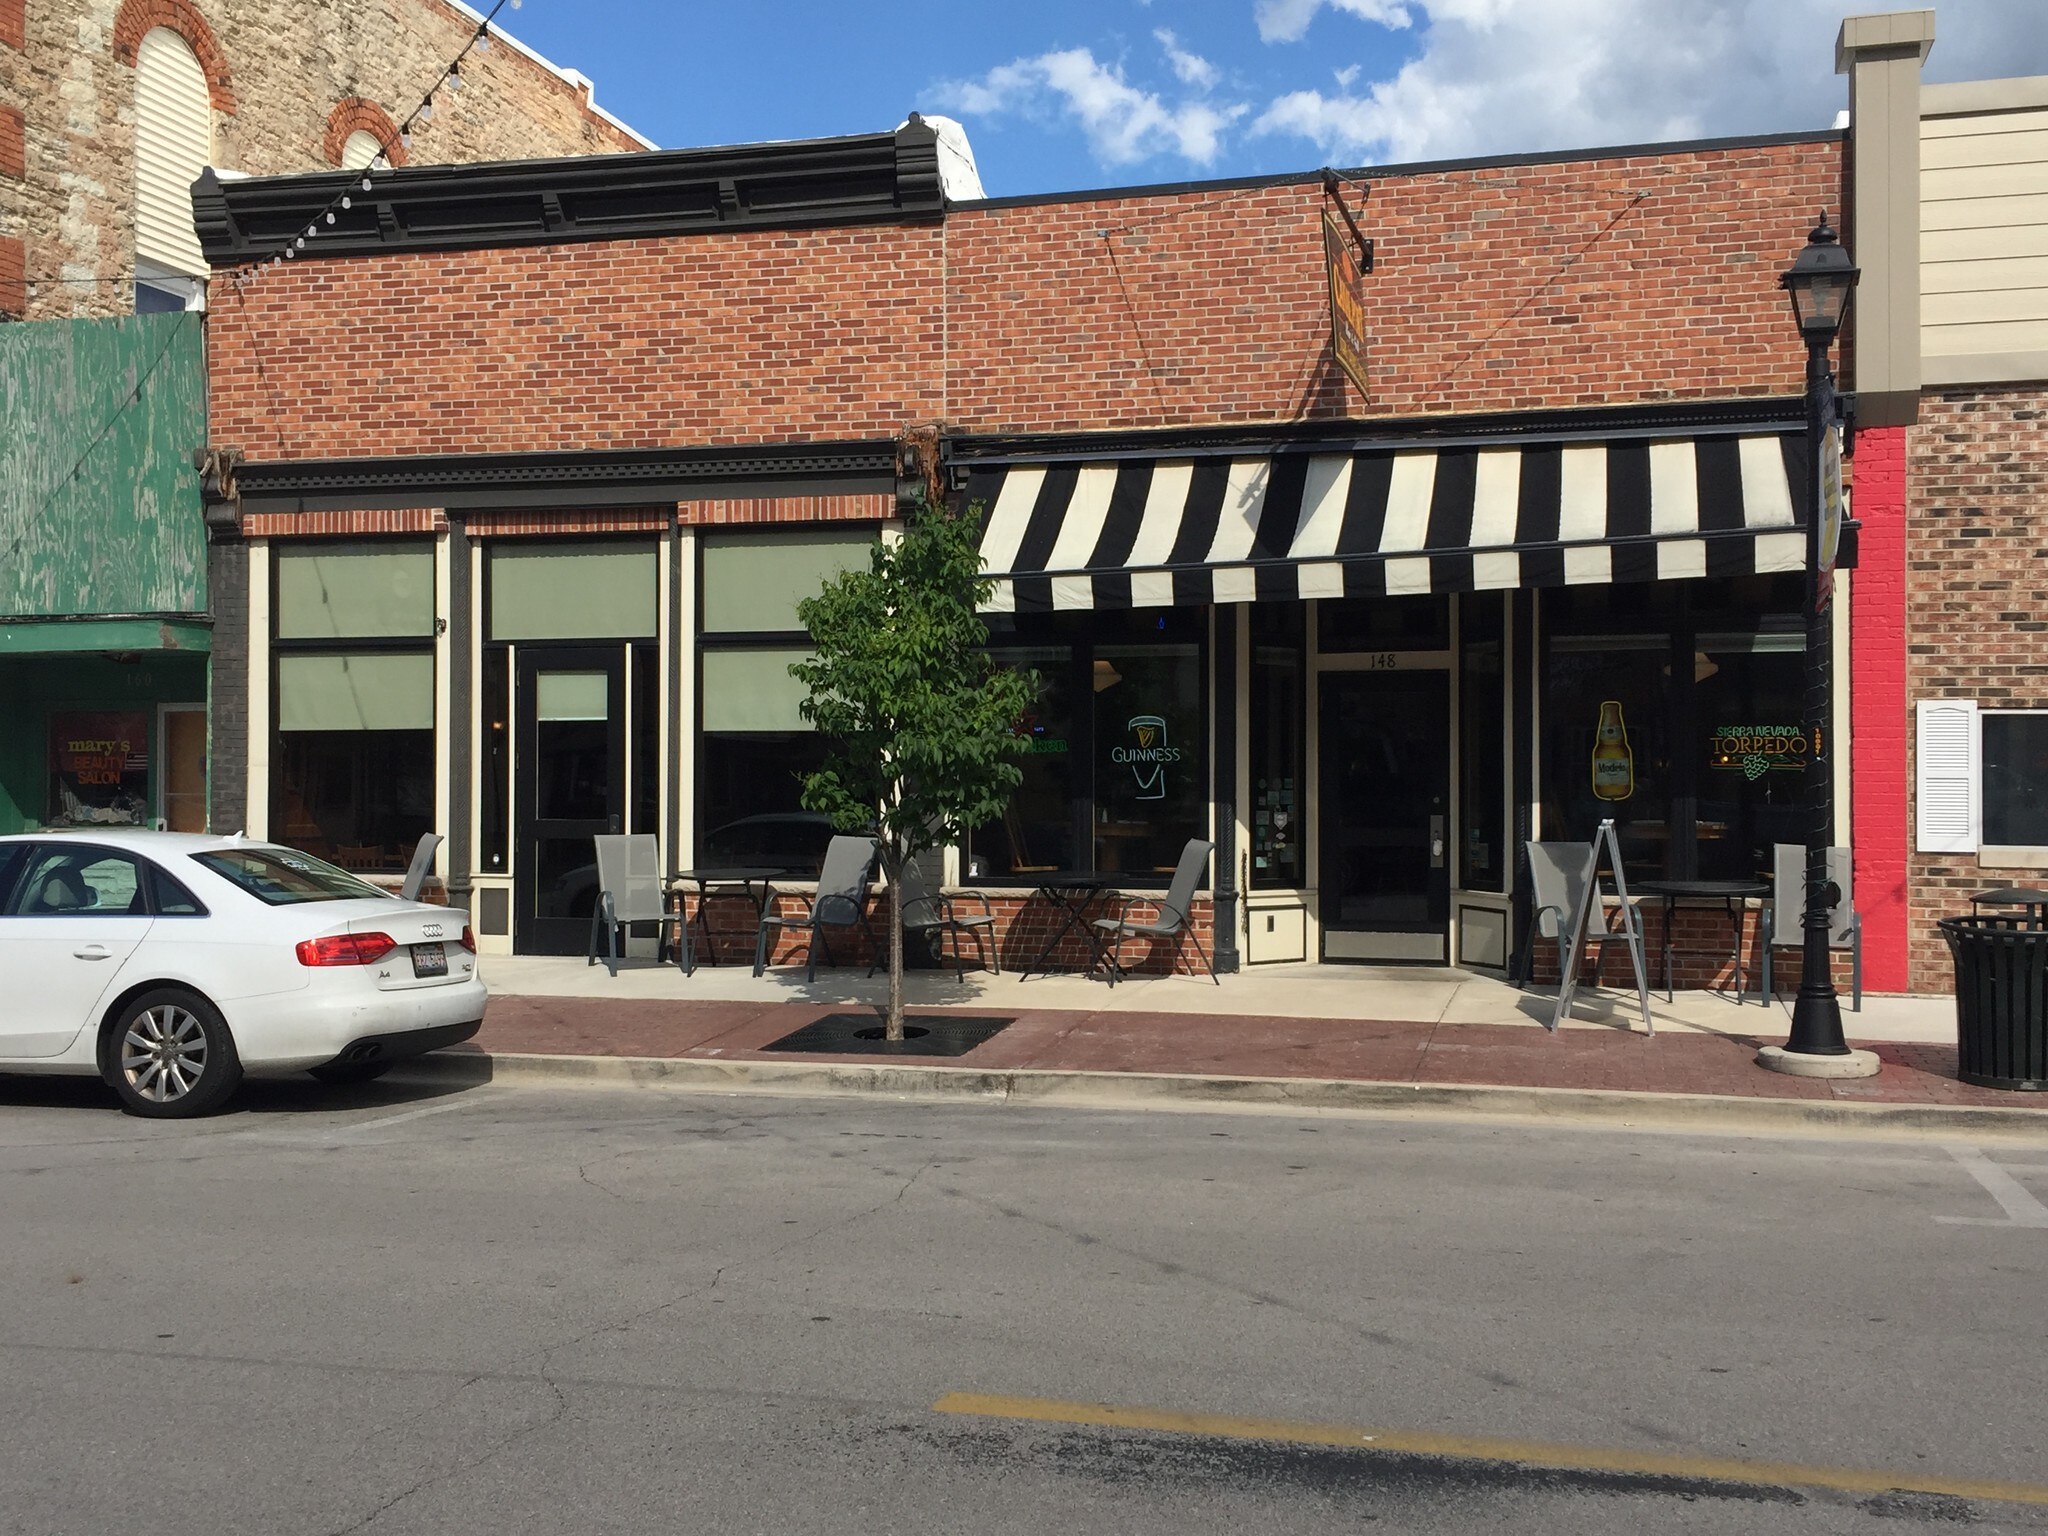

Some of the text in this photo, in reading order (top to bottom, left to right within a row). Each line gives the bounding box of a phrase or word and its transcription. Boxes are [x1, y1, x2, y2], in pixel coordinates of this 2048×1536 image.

[1371, 654, 1396, 669] 148
[1716, 725, 1800, 737] SIERRA NEVADA
[1709, 737, 1808, 755] TORPEDO
[1111, 746, 1181, 763] GUINNESS
[74, 756, 125, 770] BEAUTY
[78, 771, 121, 785] SALON
[378, 970, 391, 979] A4
